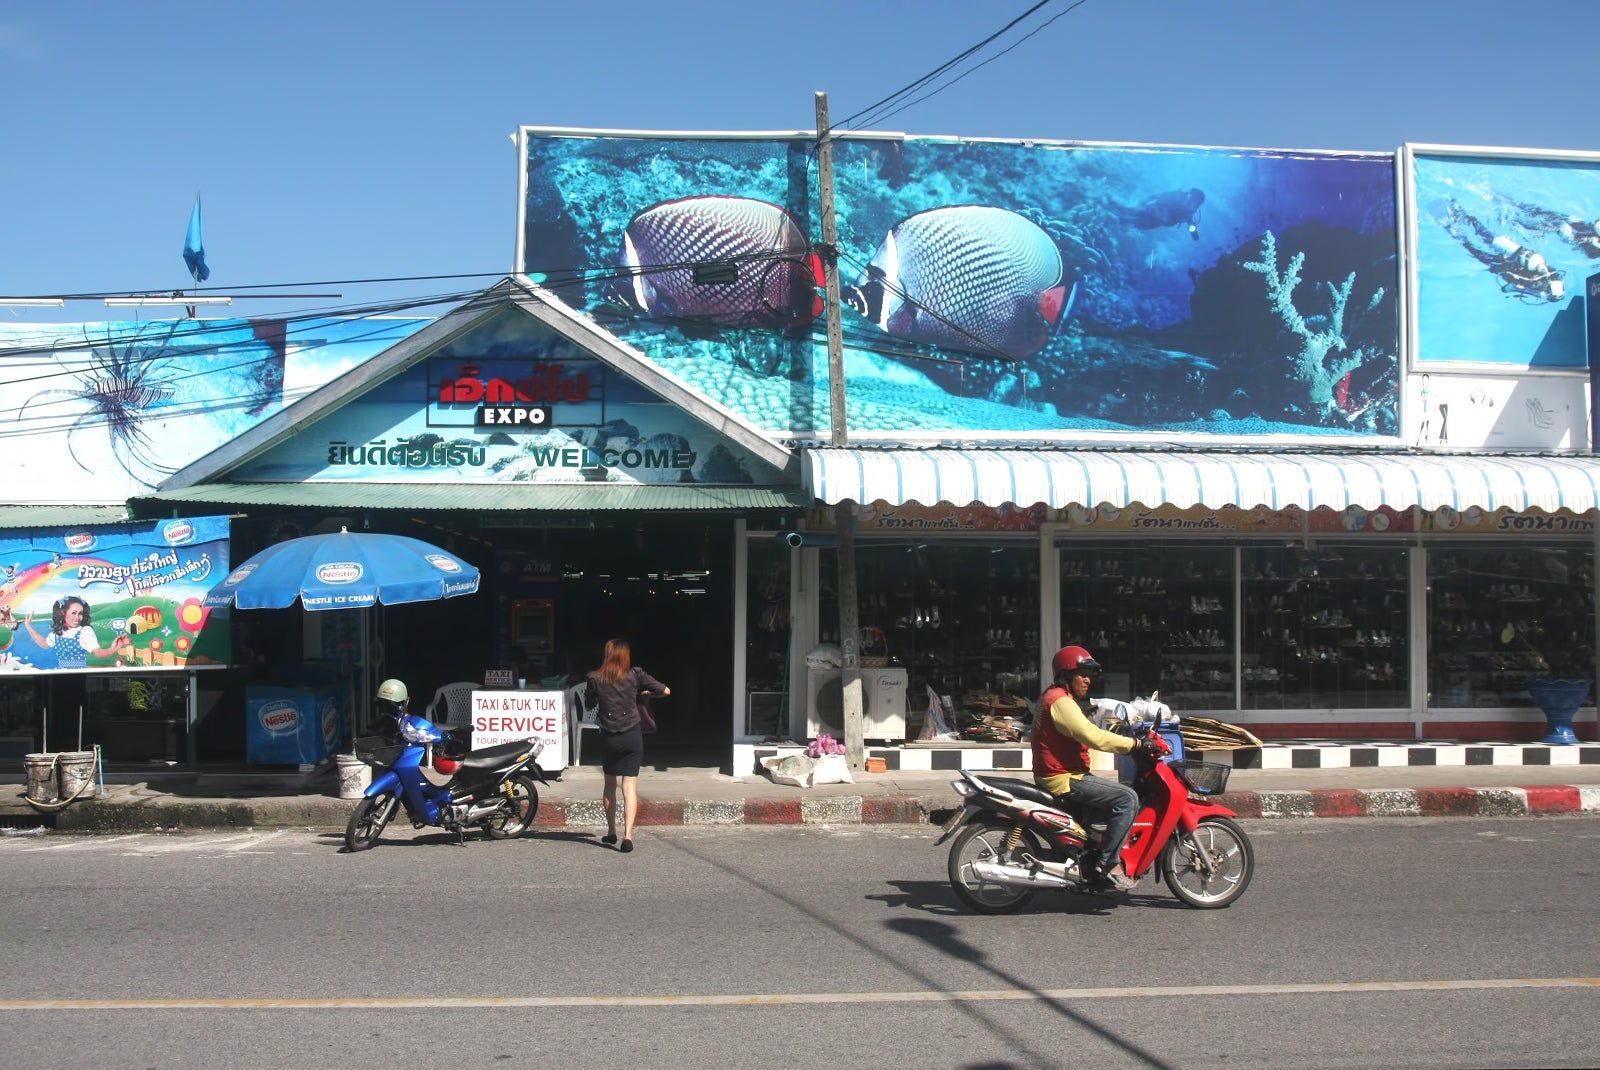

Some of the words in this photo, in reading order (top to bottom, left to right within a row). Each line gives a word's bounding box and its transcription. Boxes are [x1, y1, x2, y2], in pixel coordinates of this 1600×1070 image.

[484, 408, 545, 424] EXPO
[327, 438, 486, 467] ยินดีต้อนรับ
[532, 447, 691, 469] WELCOME
[522, 563, 552, 574] ATM
[348, 594, 374, 602] CREAM
[487, 670, 510, 678] TAXI
[476, 698, 499, 711] TAXI
[534, 698, 556, 711] TUK
[475, 716, 557, 733] SERVICE
[476, 737, 499, 745] TOUR
